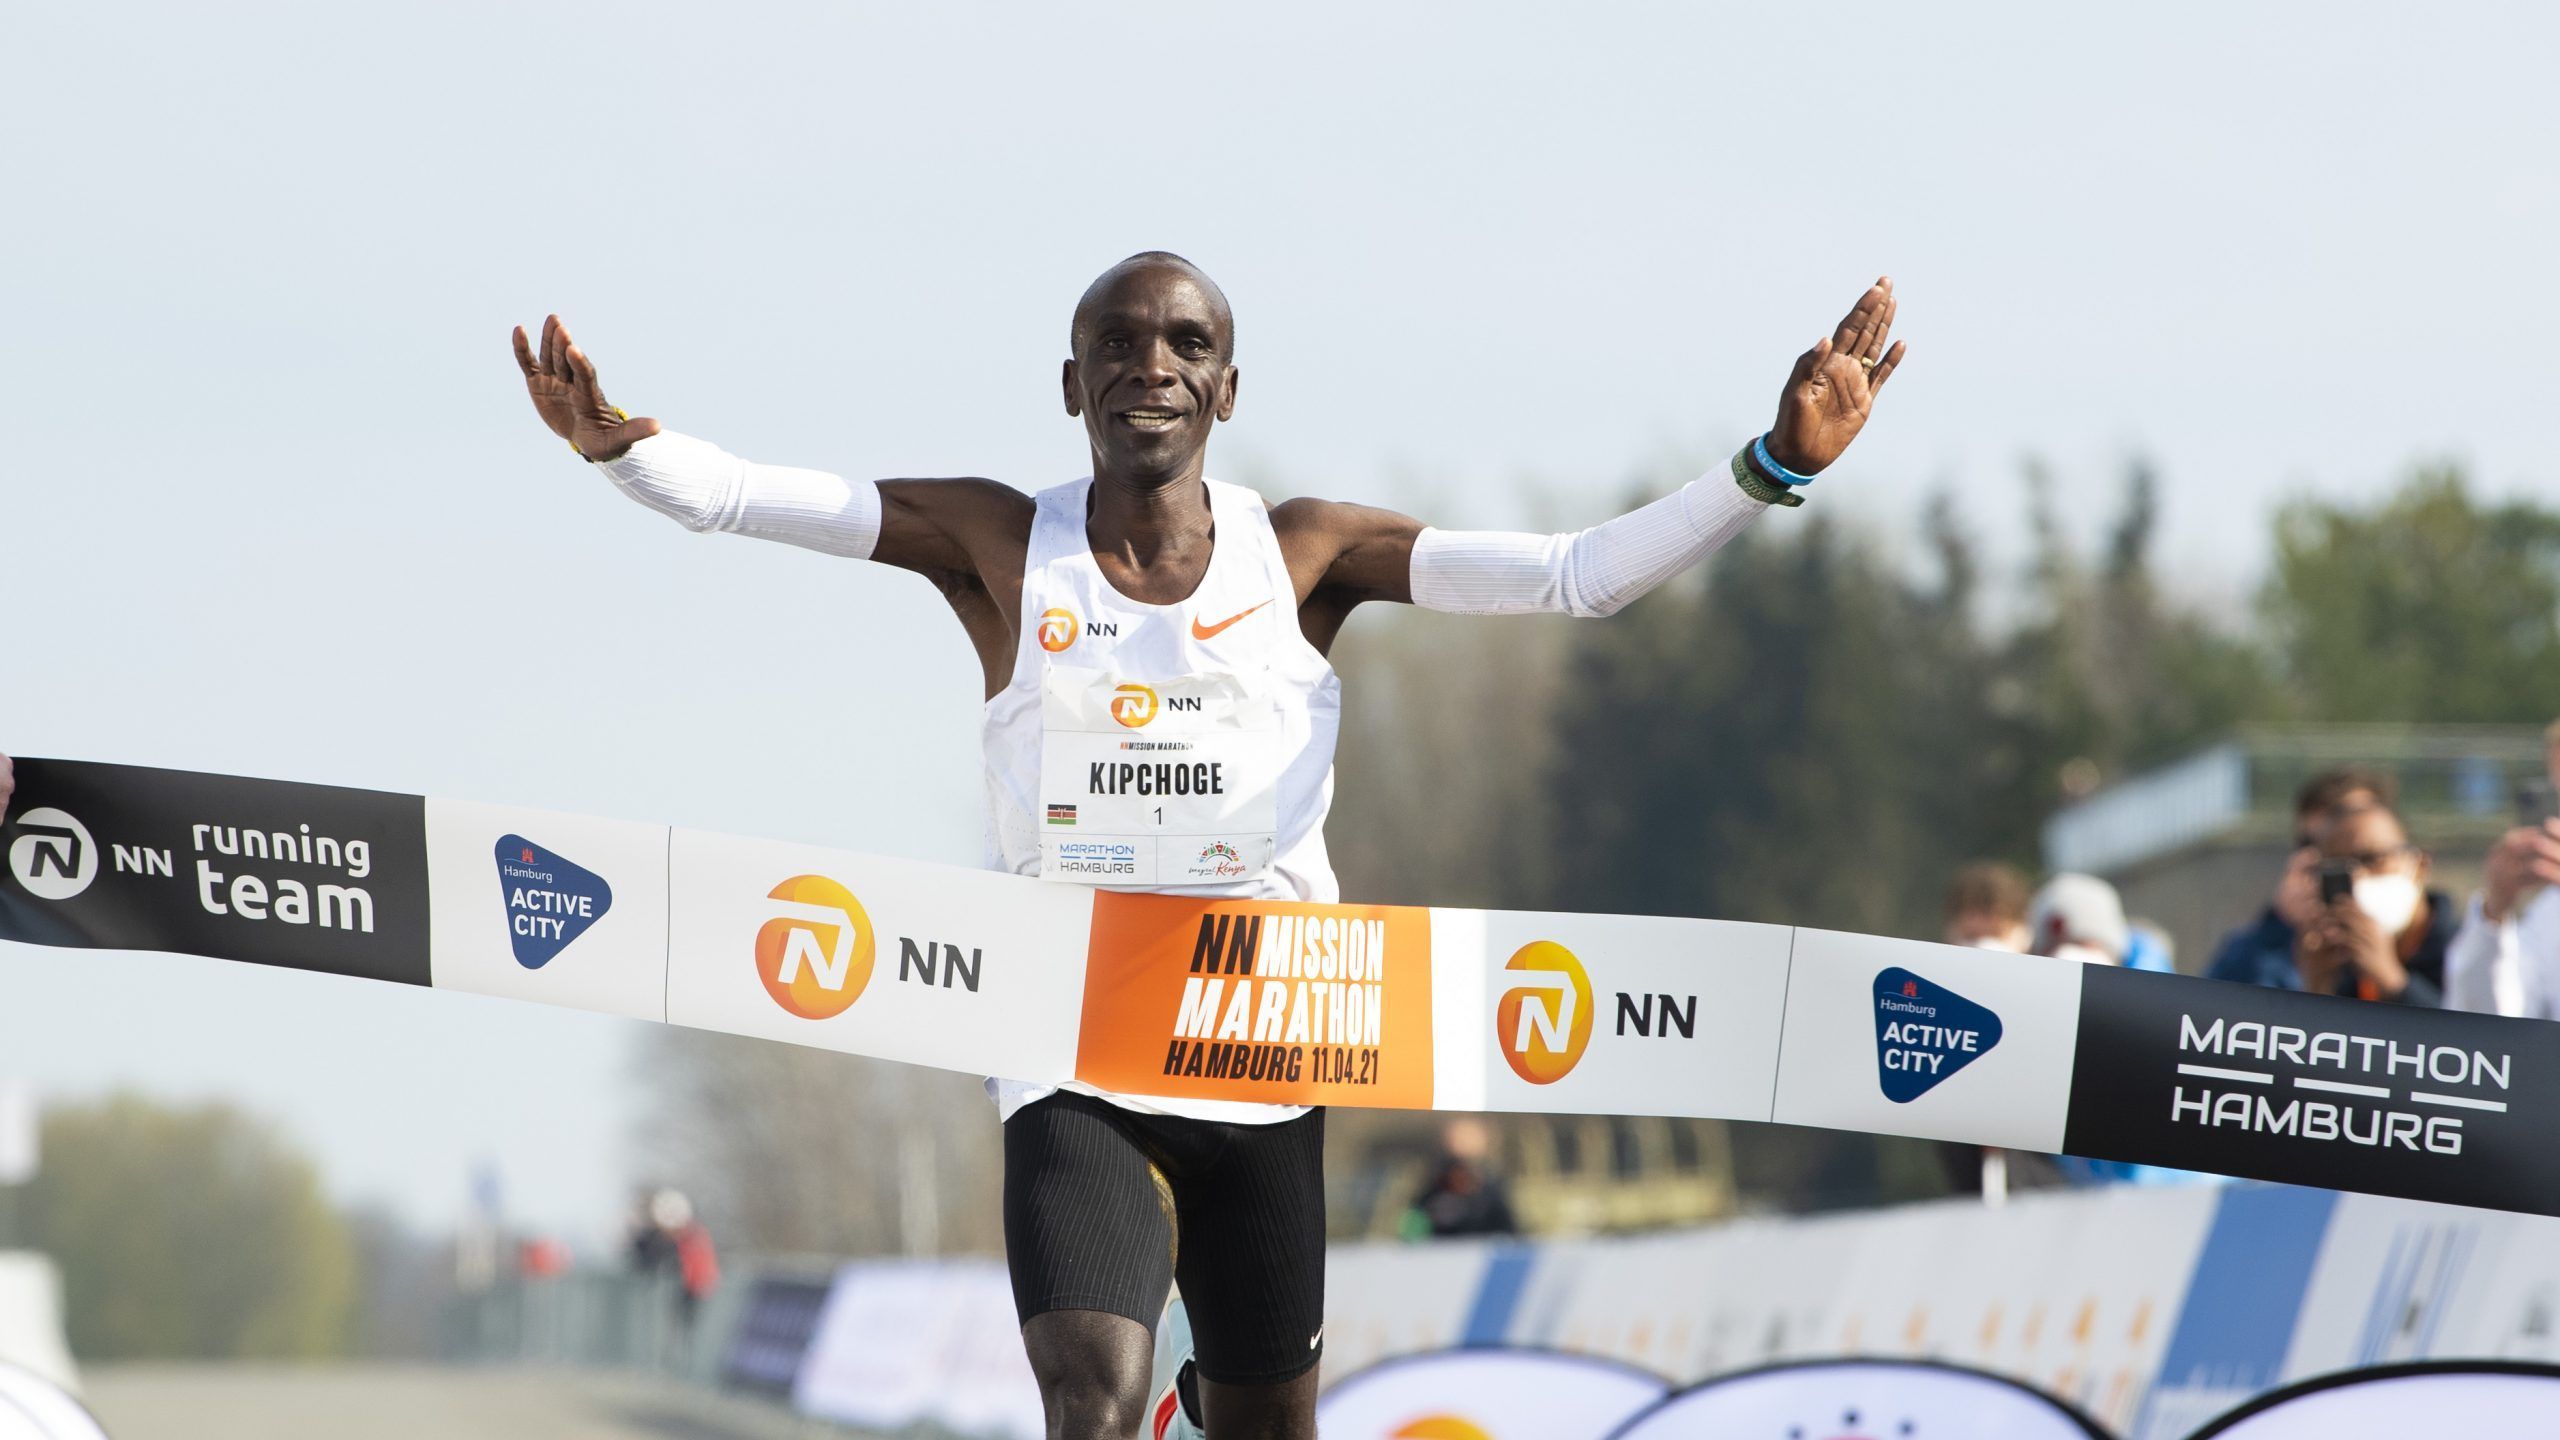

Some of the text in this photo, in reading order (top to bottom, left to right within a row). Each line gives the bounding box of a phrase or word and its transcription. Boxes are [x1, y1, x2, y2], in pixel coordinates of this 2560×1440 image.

[1087, 622, 1118, 637] NN
[1168, 697, 1202, 712] NN
[1089, 762, 1223, 796] KIPCHOGE
[1154, 806, 1162, 825] 1
[112, 844, 173, 877] NN
[192, 823, 371, 878] running
[1060, 844, 1134, 855] MARATHON
[504, 865, 553, 883] Hamburg
[1060, 861, 1134, 874] HAMBURG
[1215, 861, 1246, 876] Kenya
[196, 859, 374, 933] team
[511, 887, 593, 918] ACTIVE
[514, 914, 566, 940] CITY
[899, 936, 982, 993] NN
[1173, 977, 1382, 1046] MARATHON
[1615, 992, 1697, 1039] NN
[1880, 999, 1936, 1018] Hamburg
[1883, 1021, 1979, 1052] ACTIVE
[2179, 1014, 2511, 1090] MARATHON
[1163, 1040, 1379, 1085] HAMBURG 11.04.21
[1884, 1048, 1944, 1075] CITY
[2171, 1086, 2463, 1155] HAMBURG
